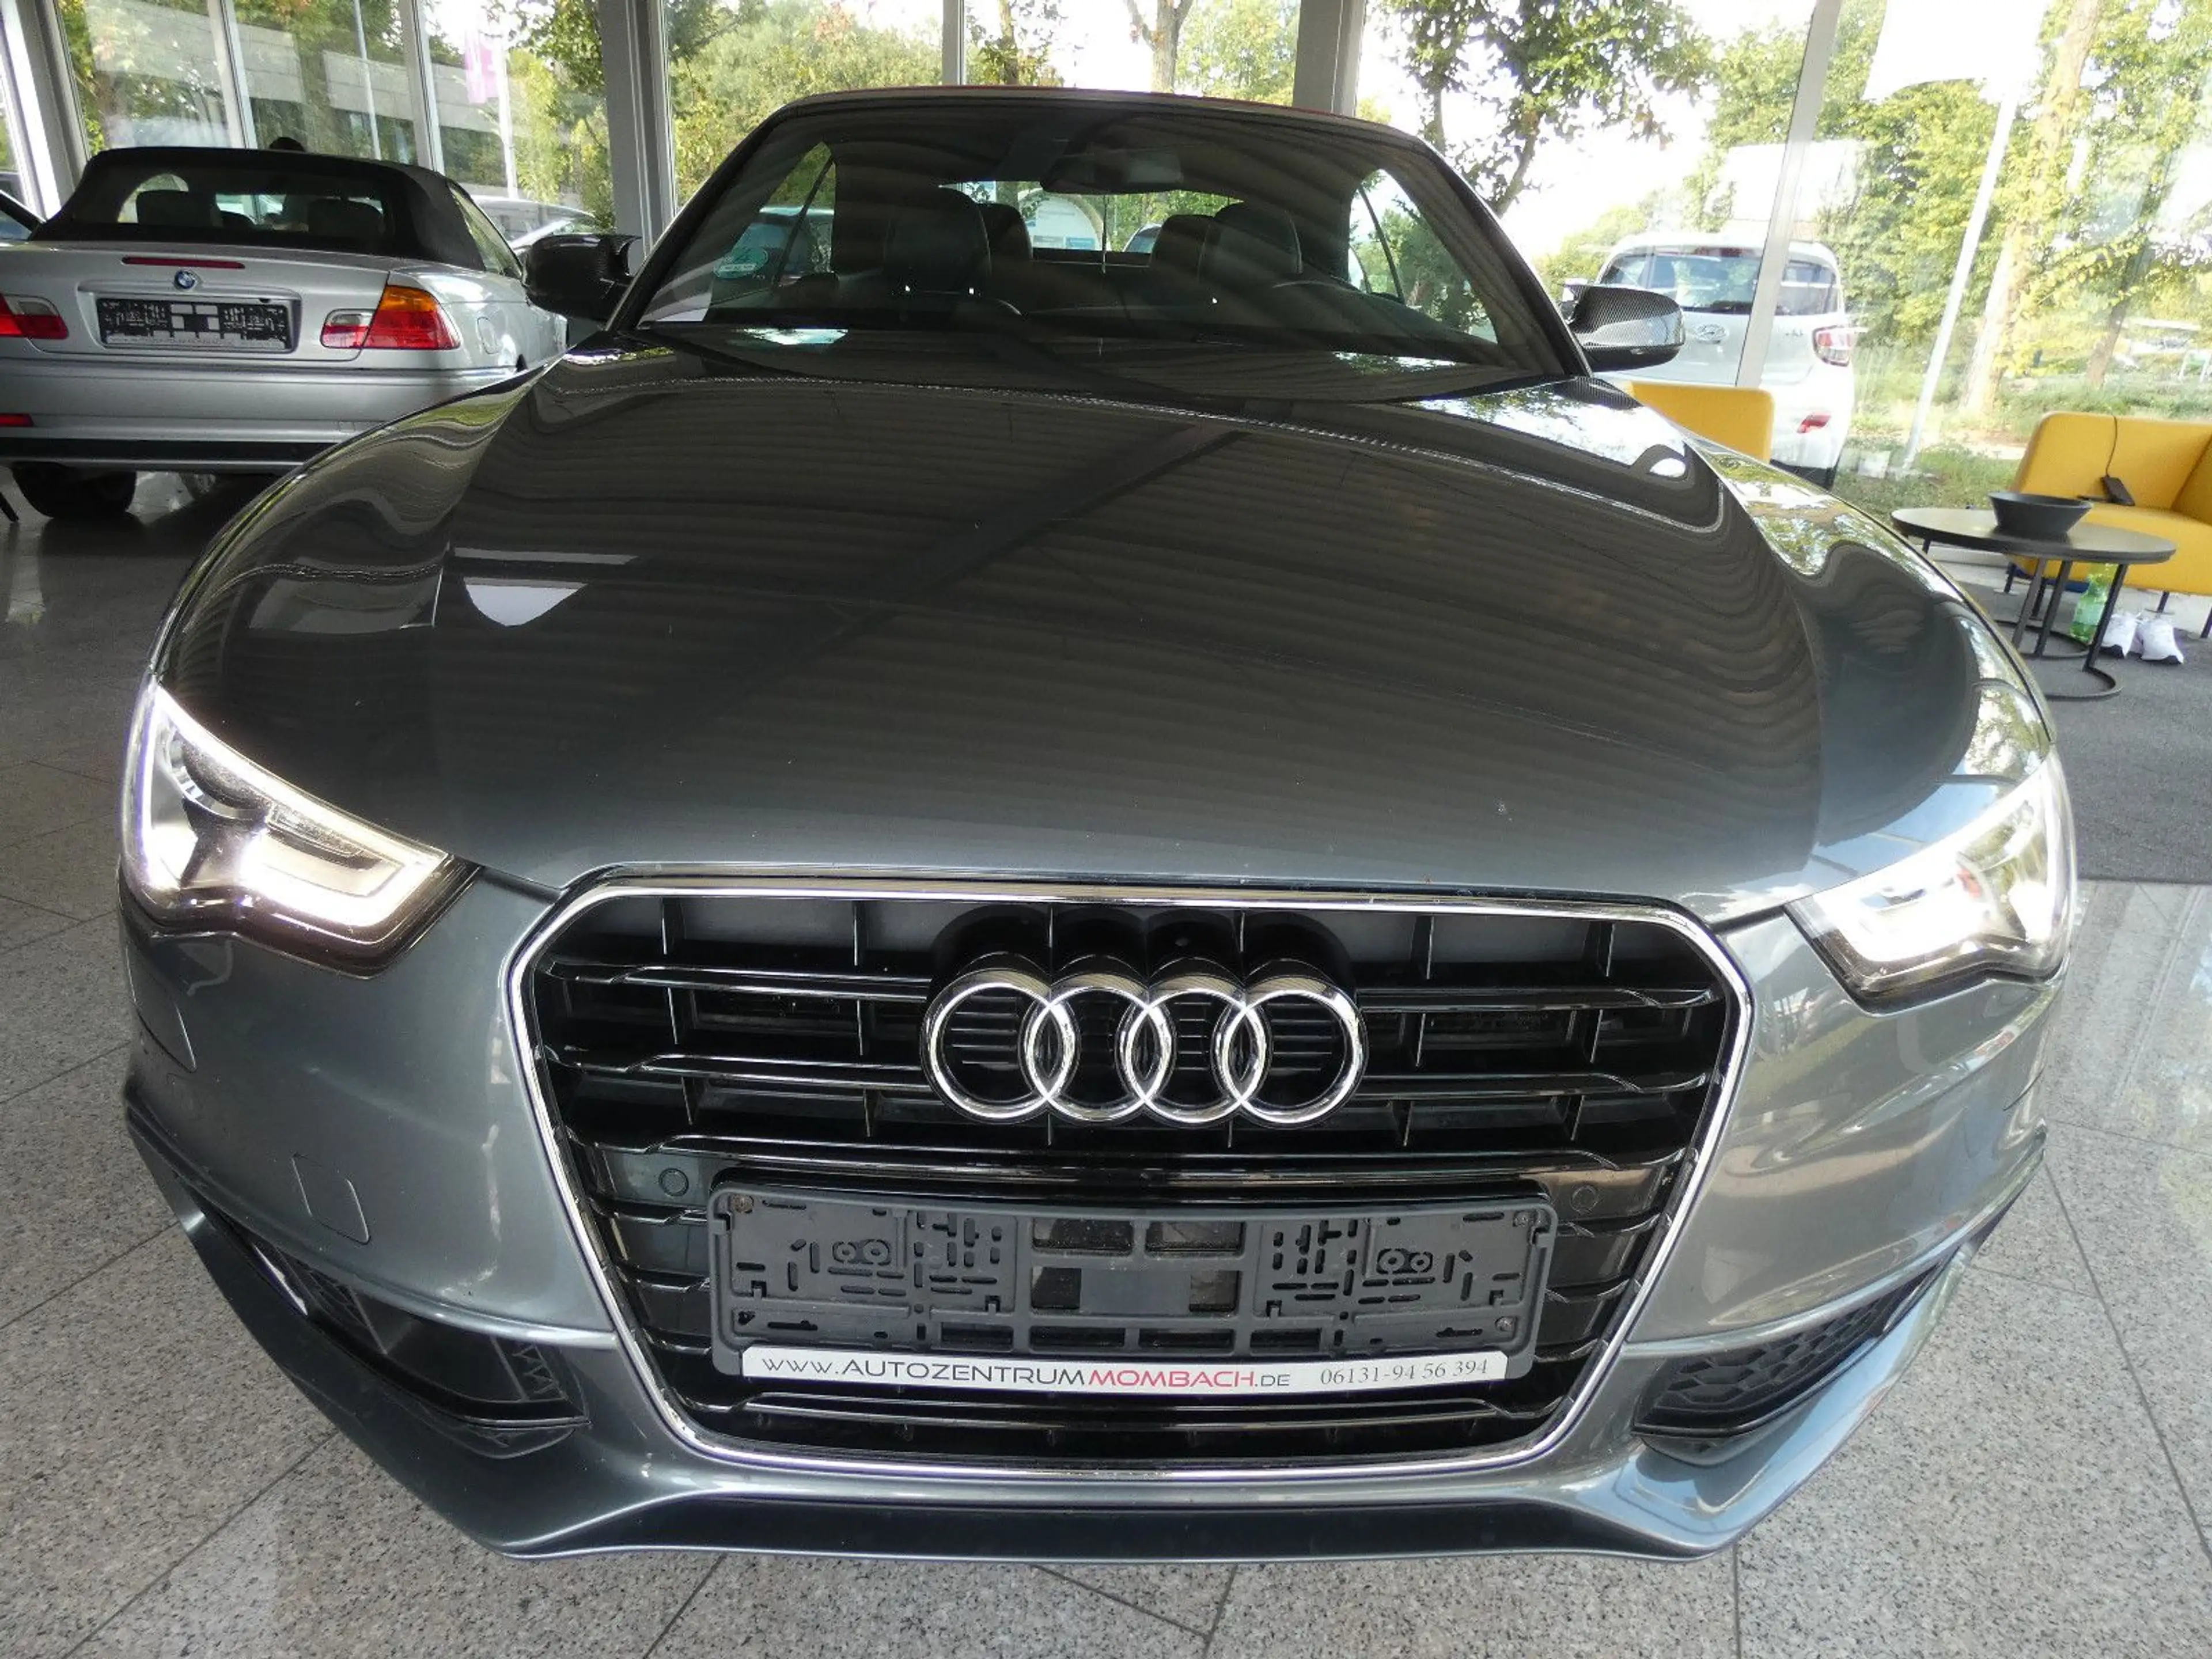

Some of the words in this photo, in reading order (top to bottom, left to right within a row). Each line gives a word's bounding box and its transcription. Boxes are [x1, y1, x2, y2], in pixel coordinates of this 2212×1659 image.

[1320, 1364, 1415, 1385] 06131-94
[1421, 1362, 1446, 1380] 56
[1452, 1358, 1488, 1375] 394
